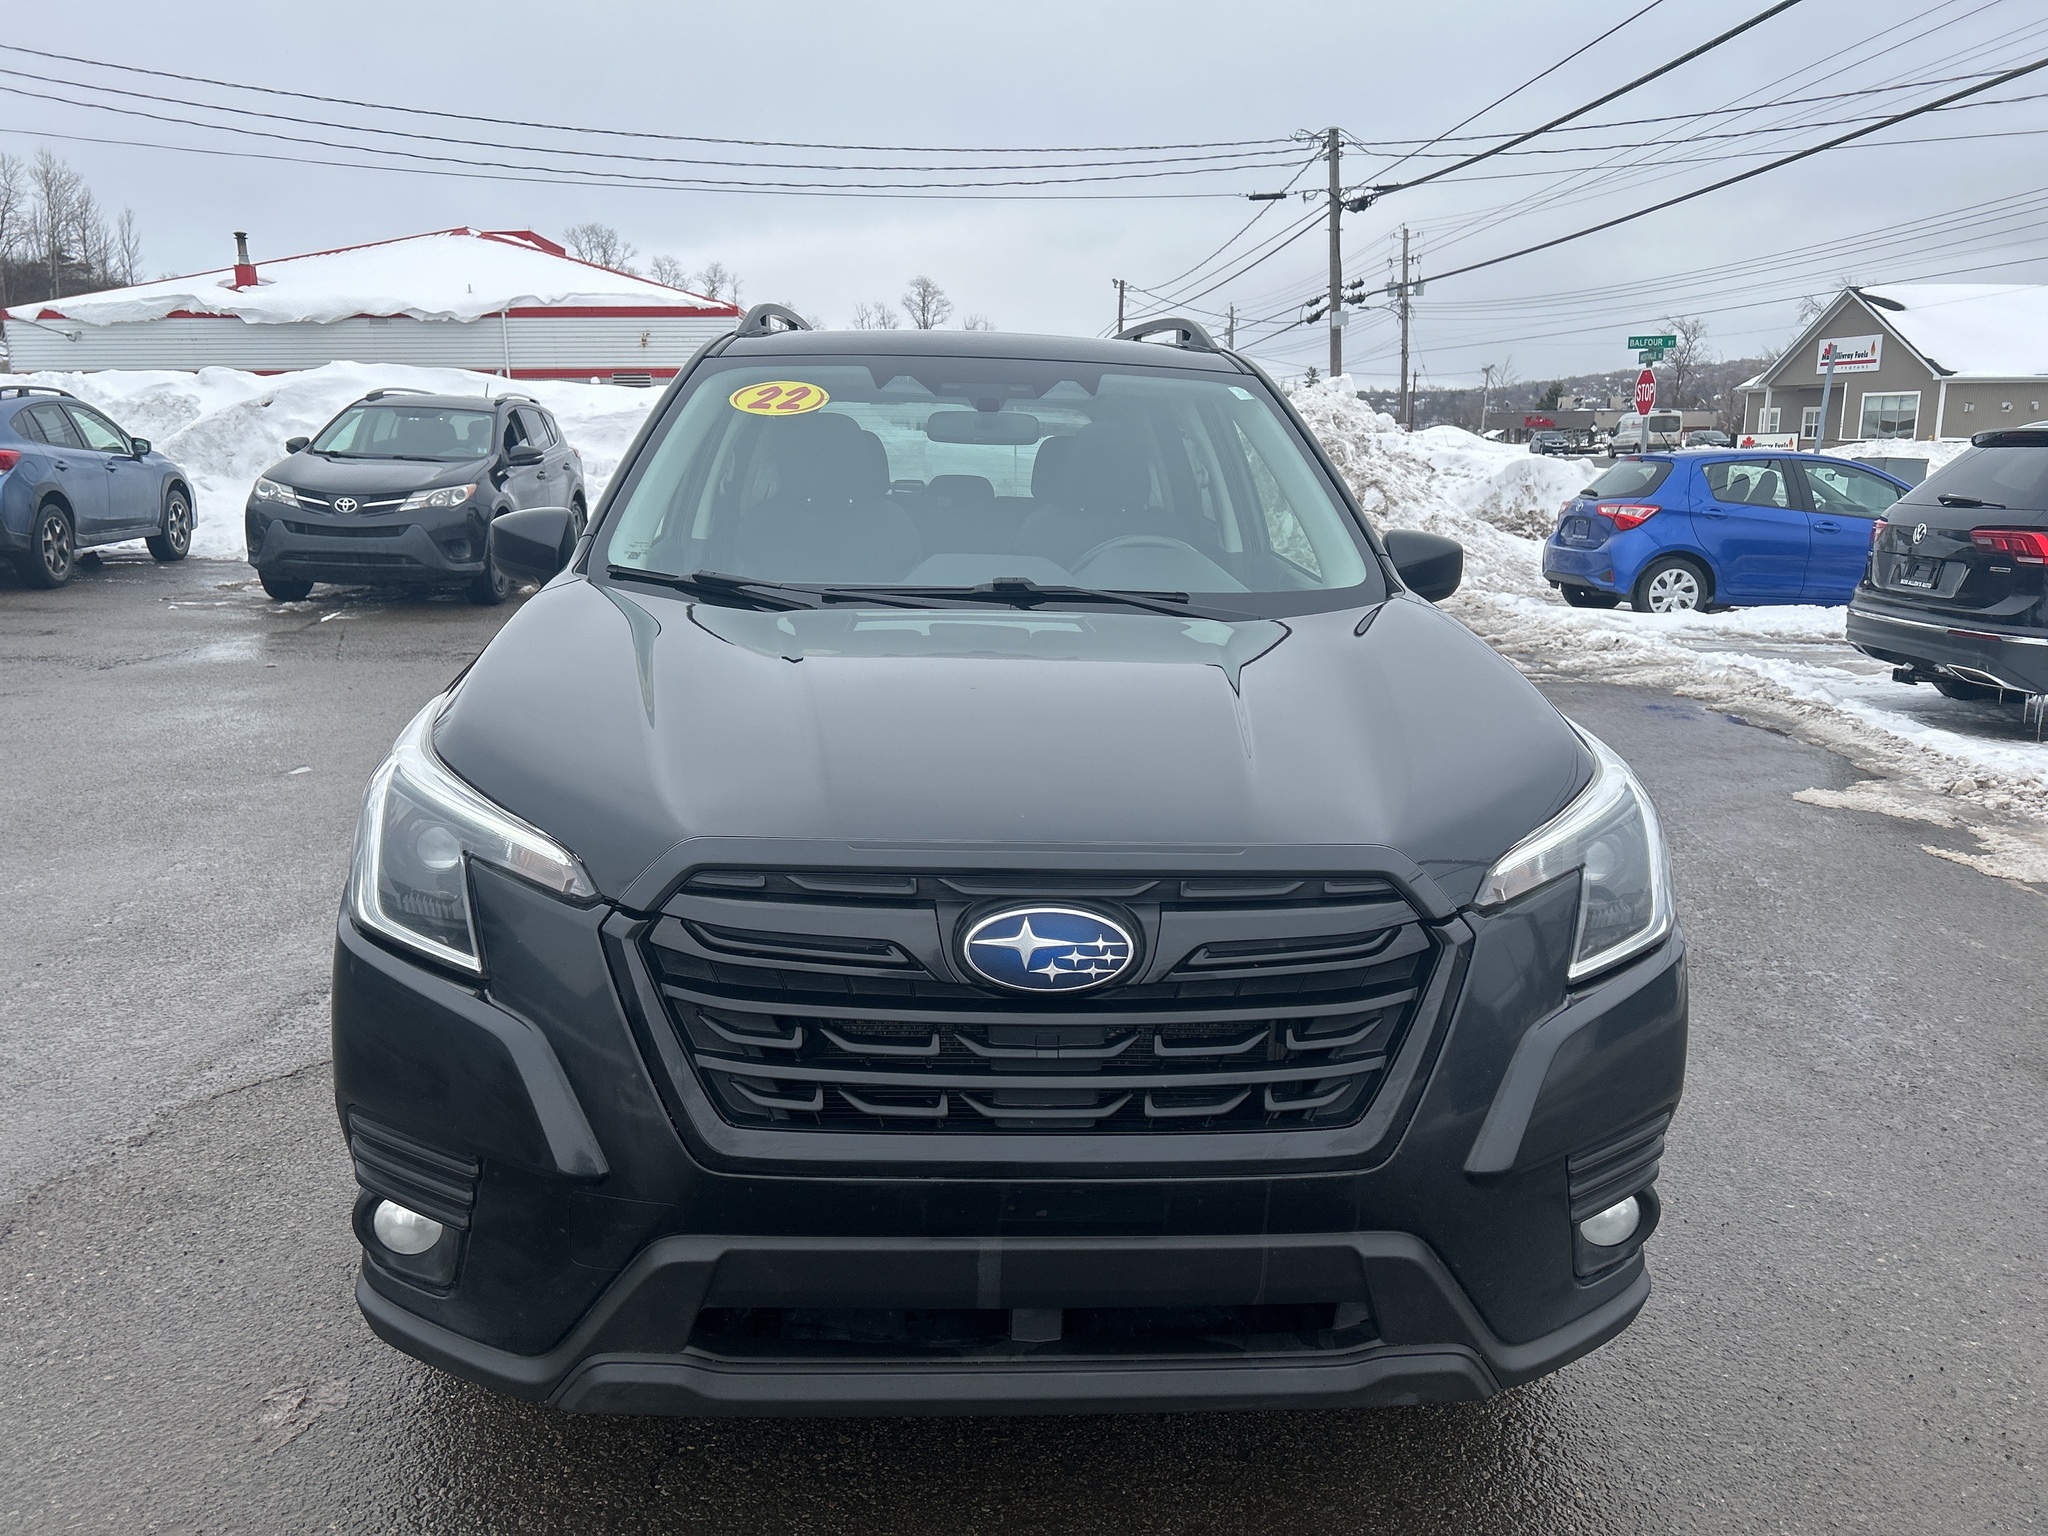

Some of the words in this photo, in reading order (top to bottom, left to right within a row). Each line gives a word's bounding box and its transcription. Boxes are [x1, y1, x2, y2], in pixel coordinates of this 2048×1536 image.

[1629, 338, 1663, 346] BALFOUR
[1854, 350, 1869, 359] Fuels
[747, 386, 812, 410] 22
[1636, 383, 1655, 402] STOP
